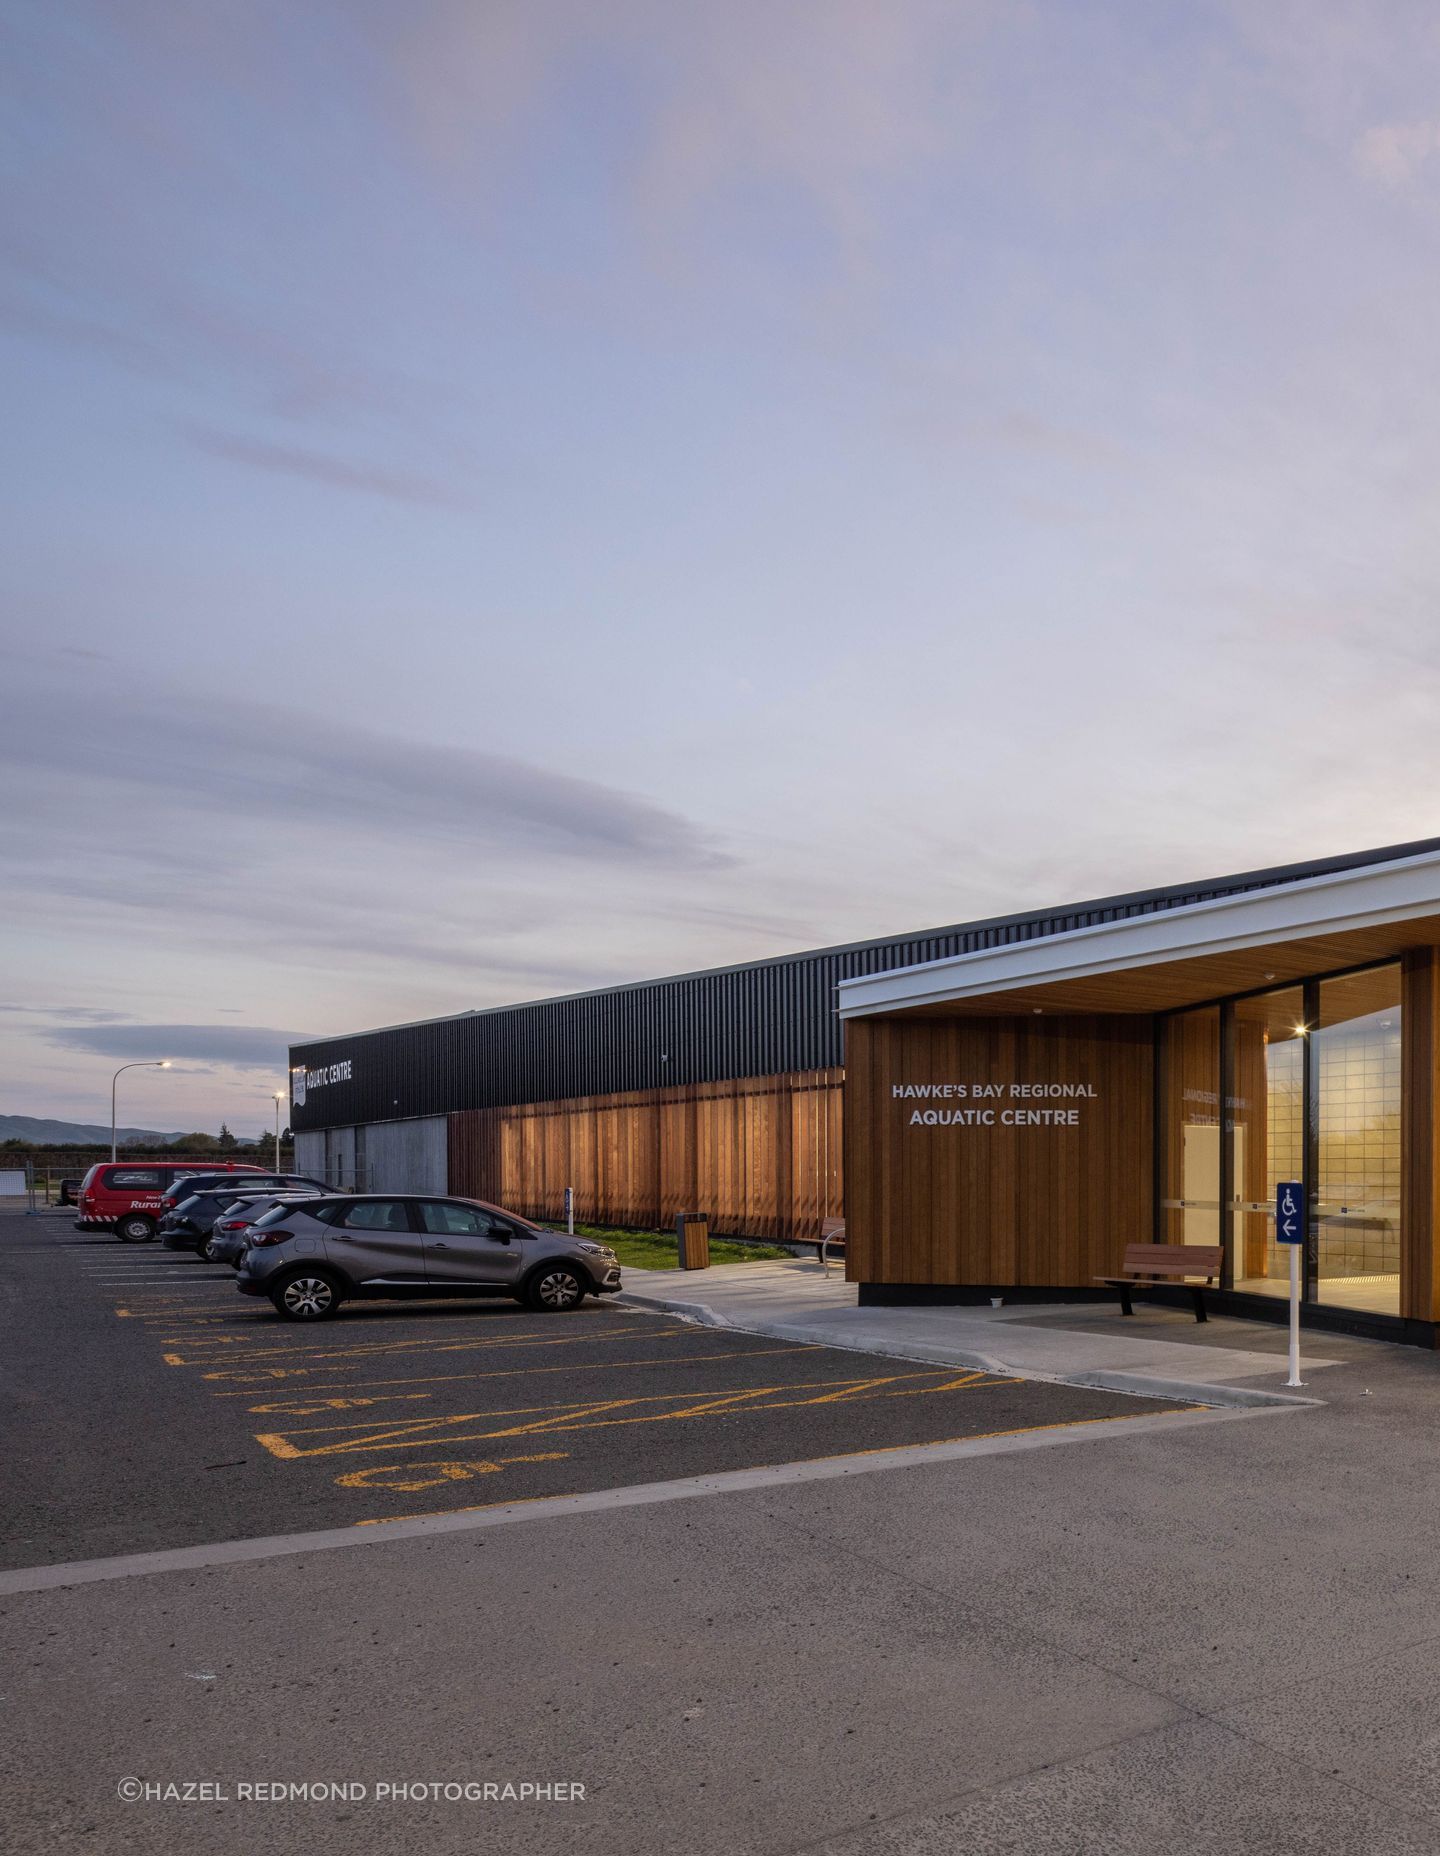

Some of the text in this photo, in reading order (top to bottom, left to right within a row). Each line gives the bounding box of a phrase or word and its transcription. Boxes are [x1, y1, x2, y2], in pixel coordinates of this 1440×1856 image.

[307, 1068, 329, 1090] AQUATIC
[329, 1060, 352, 1084] CENTRE
[892, 1084, 1098, 1098] HAWKE'S BAY REGIONAL
[909, 1110, 1080, 1126] AQUATIC CENTRE
